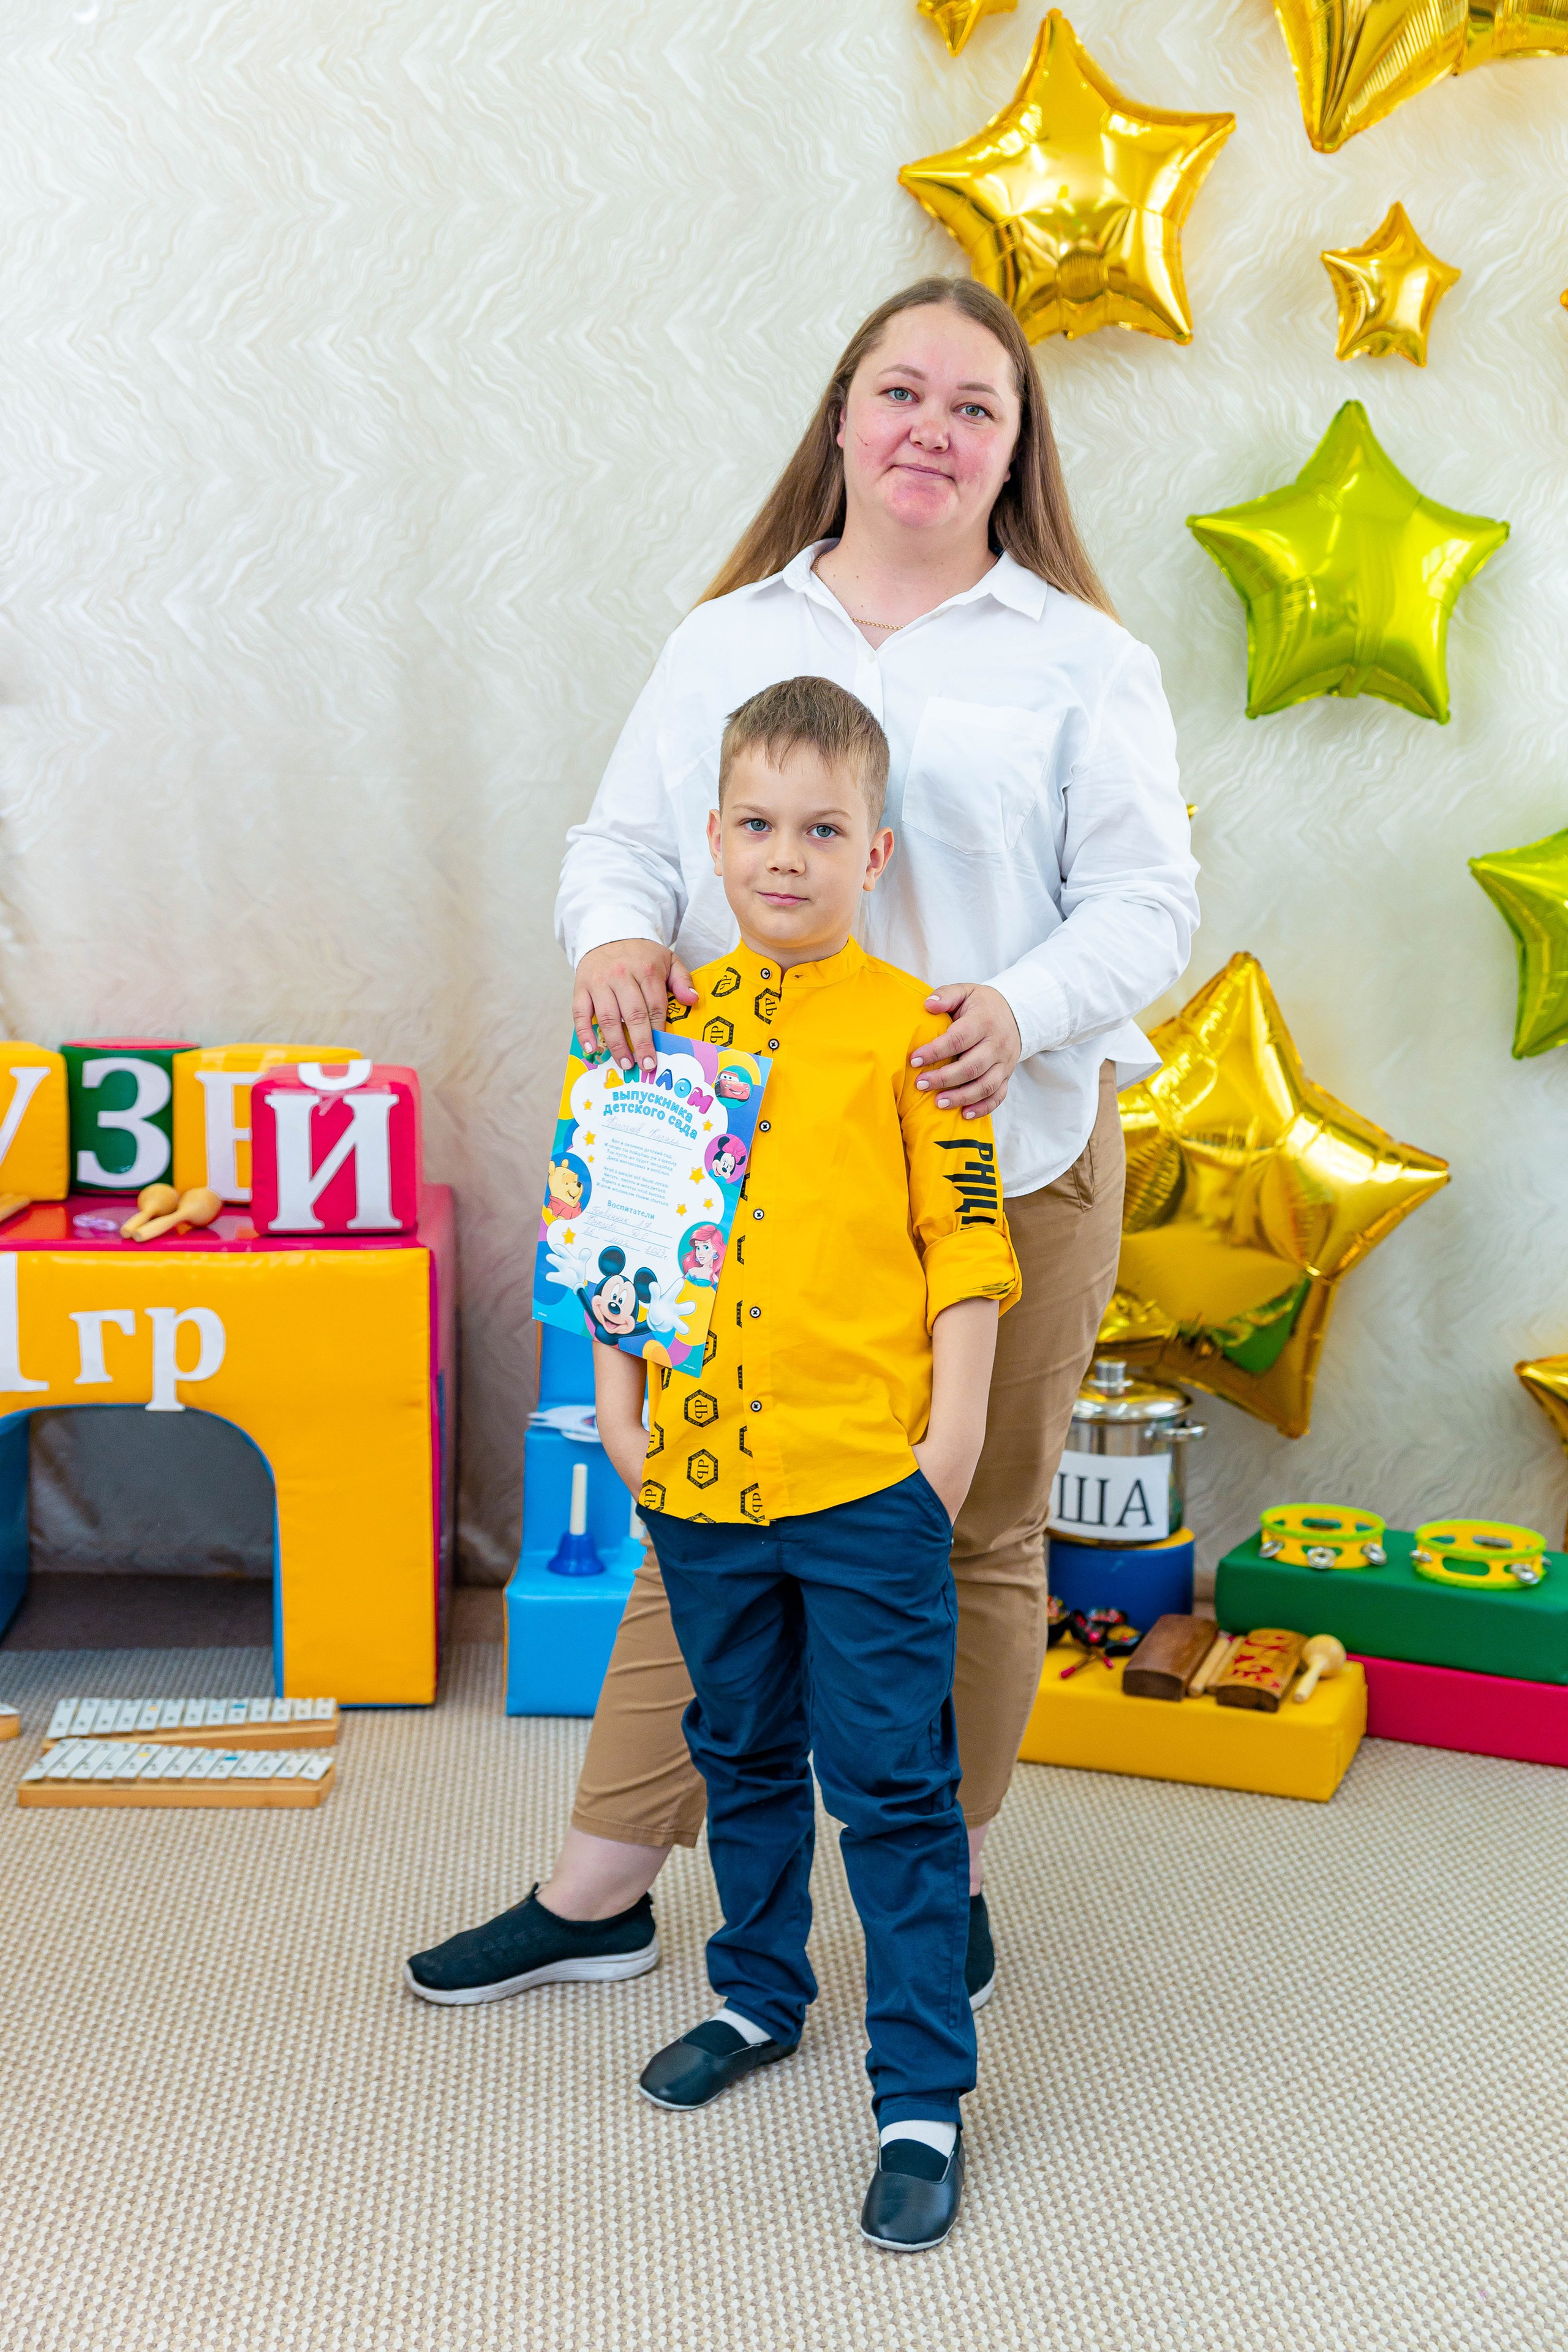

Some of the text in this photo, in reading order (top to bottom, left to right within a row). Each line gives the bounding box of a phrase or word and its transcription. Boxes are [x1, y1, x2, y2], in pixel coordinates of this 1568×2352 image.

[603, 1103, 698, 1140] детского сада
[612, 1090, 693, 1123] выпускника
[607, 1200, 655, 1219] Воспитатели
[1055, 1472, 1154, 1528] ША
